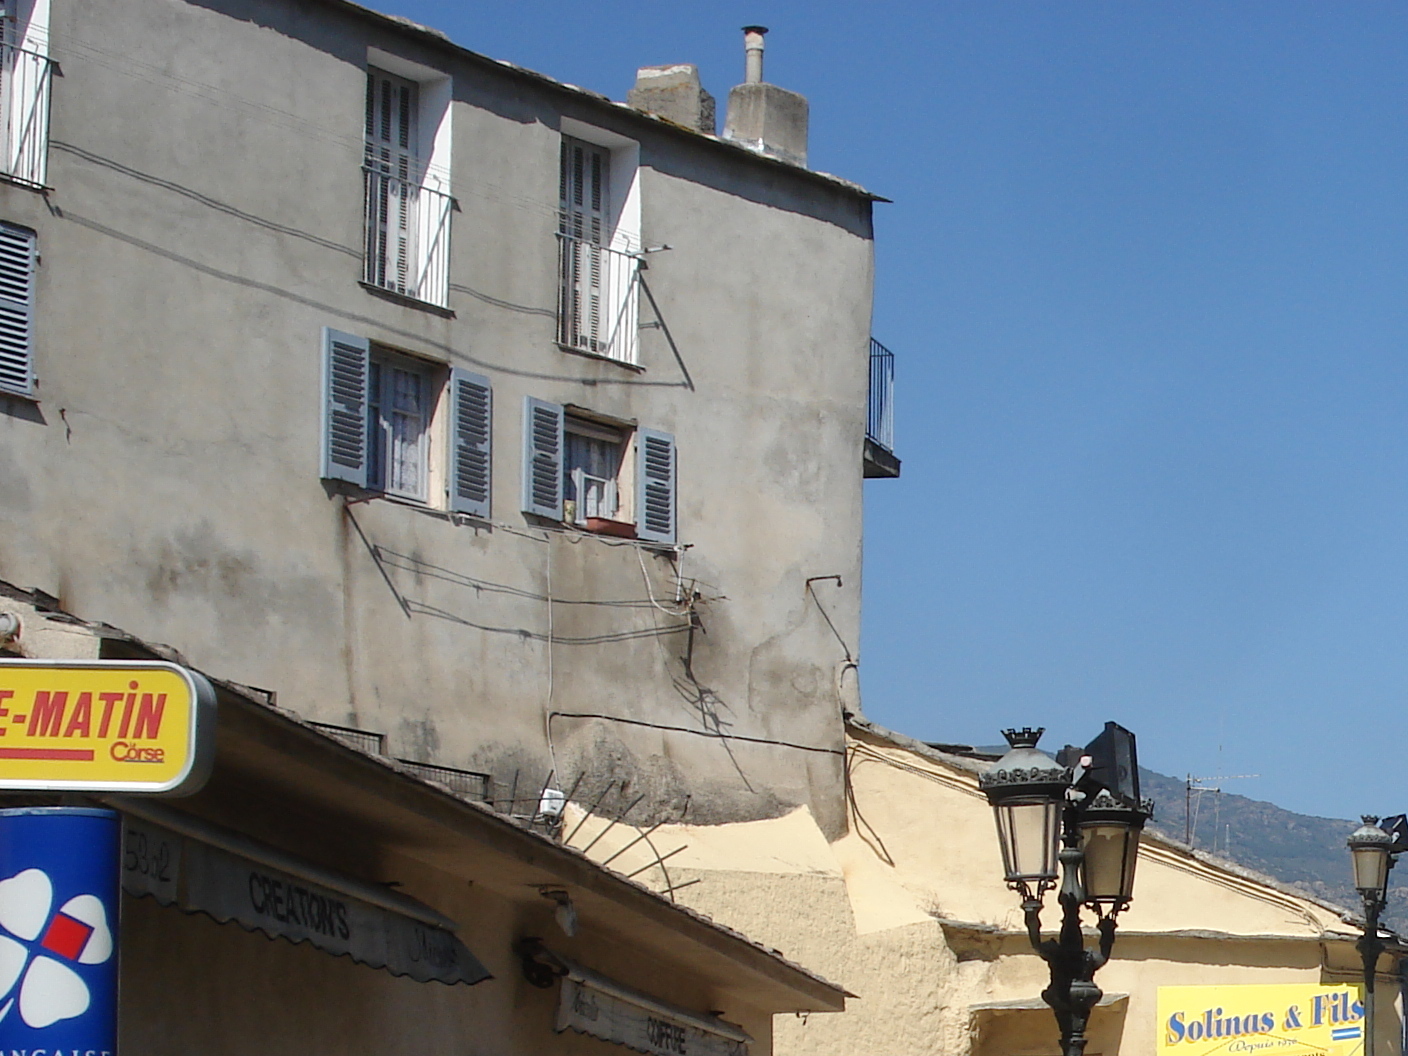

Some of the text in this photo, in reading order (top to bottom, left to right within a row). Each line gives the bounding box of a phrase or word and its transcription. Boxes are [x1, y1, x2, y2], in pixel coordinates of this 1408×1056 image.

[111, 741, 165, 763] Corse
[1166, 991, 1365, 1046] Solinas & Fils
[1228, 1039, 1274, 1054] Depuis
